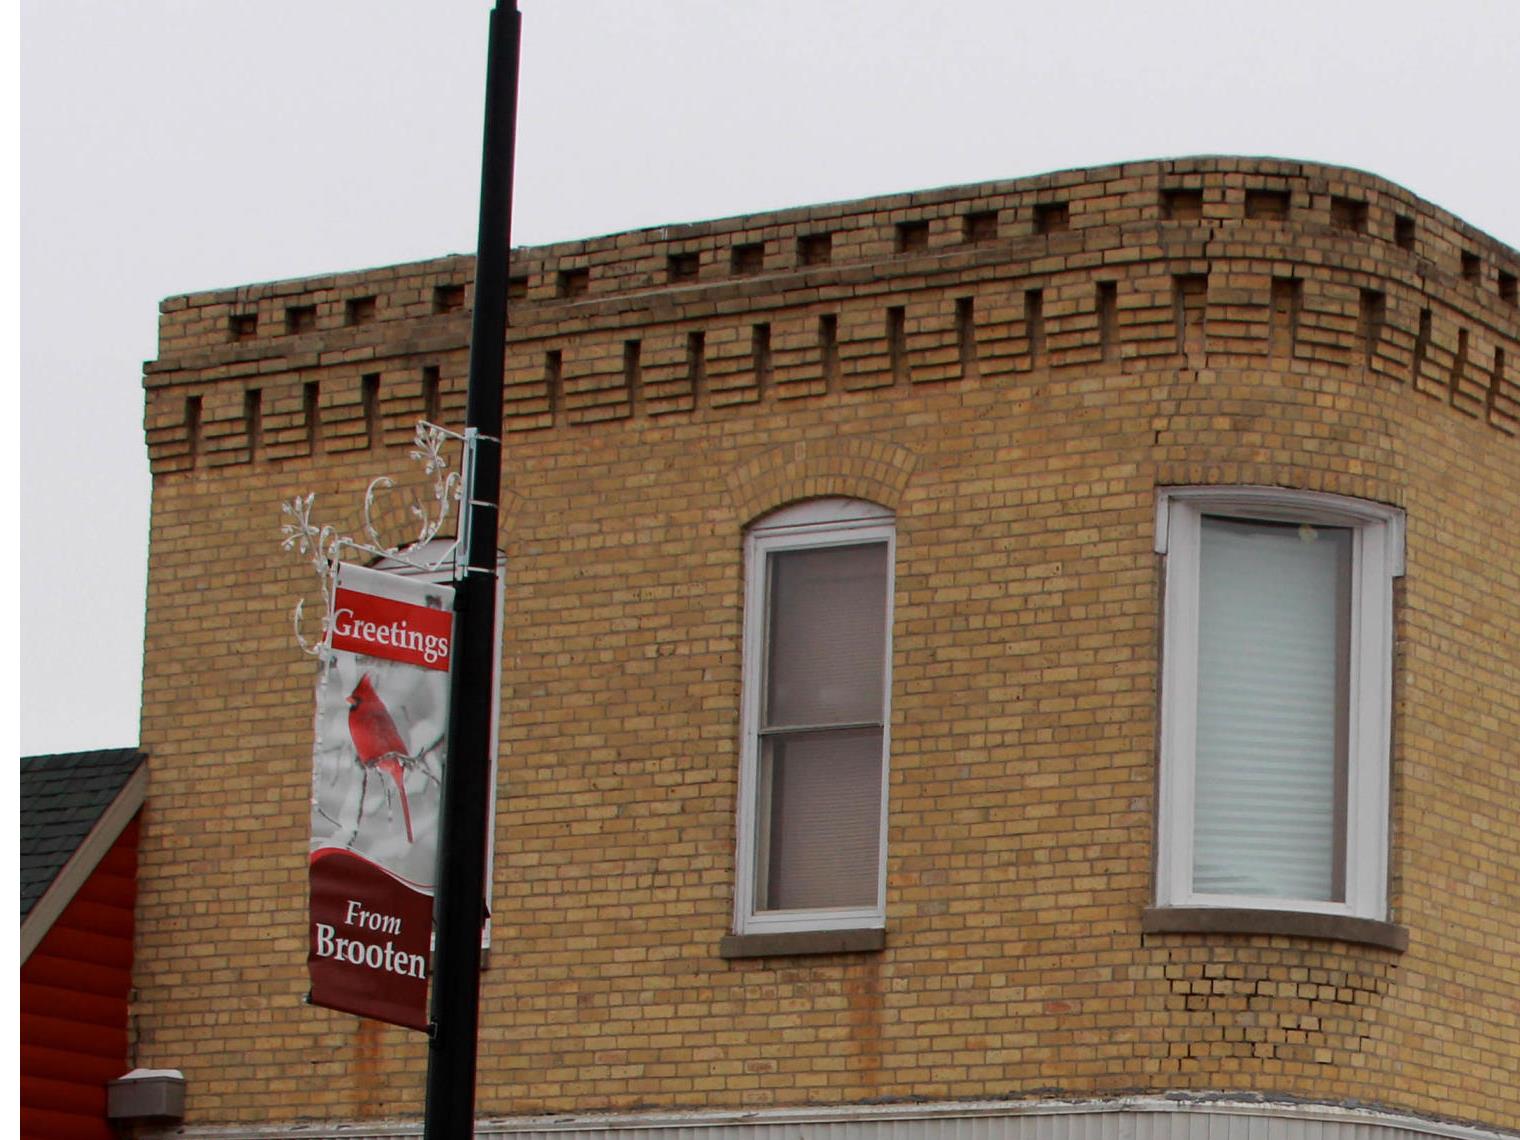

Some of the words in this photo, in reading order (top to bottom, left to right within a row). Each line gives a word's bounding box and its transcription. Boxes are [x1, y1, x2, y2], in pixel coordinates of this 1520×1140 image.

[332, 608, 449, 664] Greetings
[344, 900, 402, 935] From
[315, 923, 427, 980] Brooten
